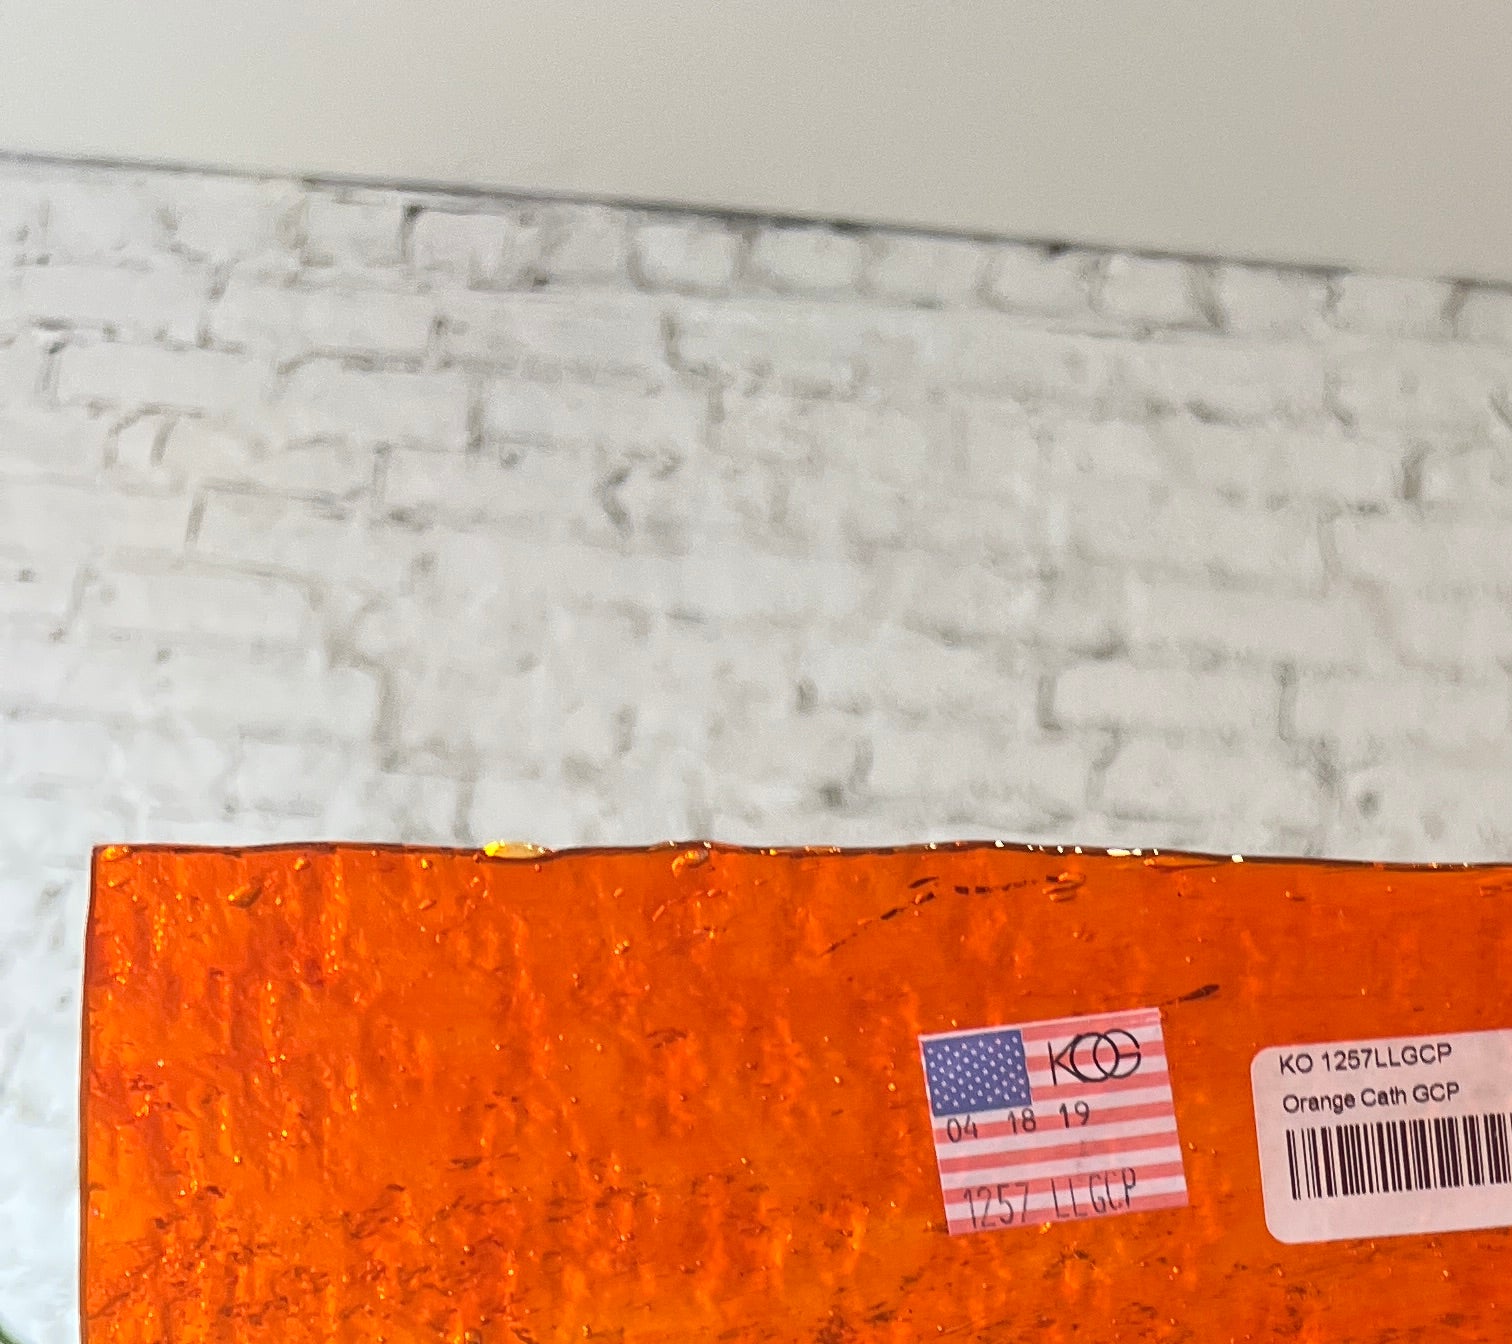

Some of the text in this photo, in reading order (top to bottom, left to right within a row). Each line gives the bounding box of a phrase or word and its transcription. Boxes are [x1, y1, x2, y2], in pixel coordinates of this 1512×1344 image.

[1279, 1042, 1452, 1074] KO 1257LLGCP
[1283, 1082, 1460, 1114] Orange Cath GCP
[946, 1101, 1090, 1143] 04 18 19
[963, 1182, 1029, 1229] 1257
